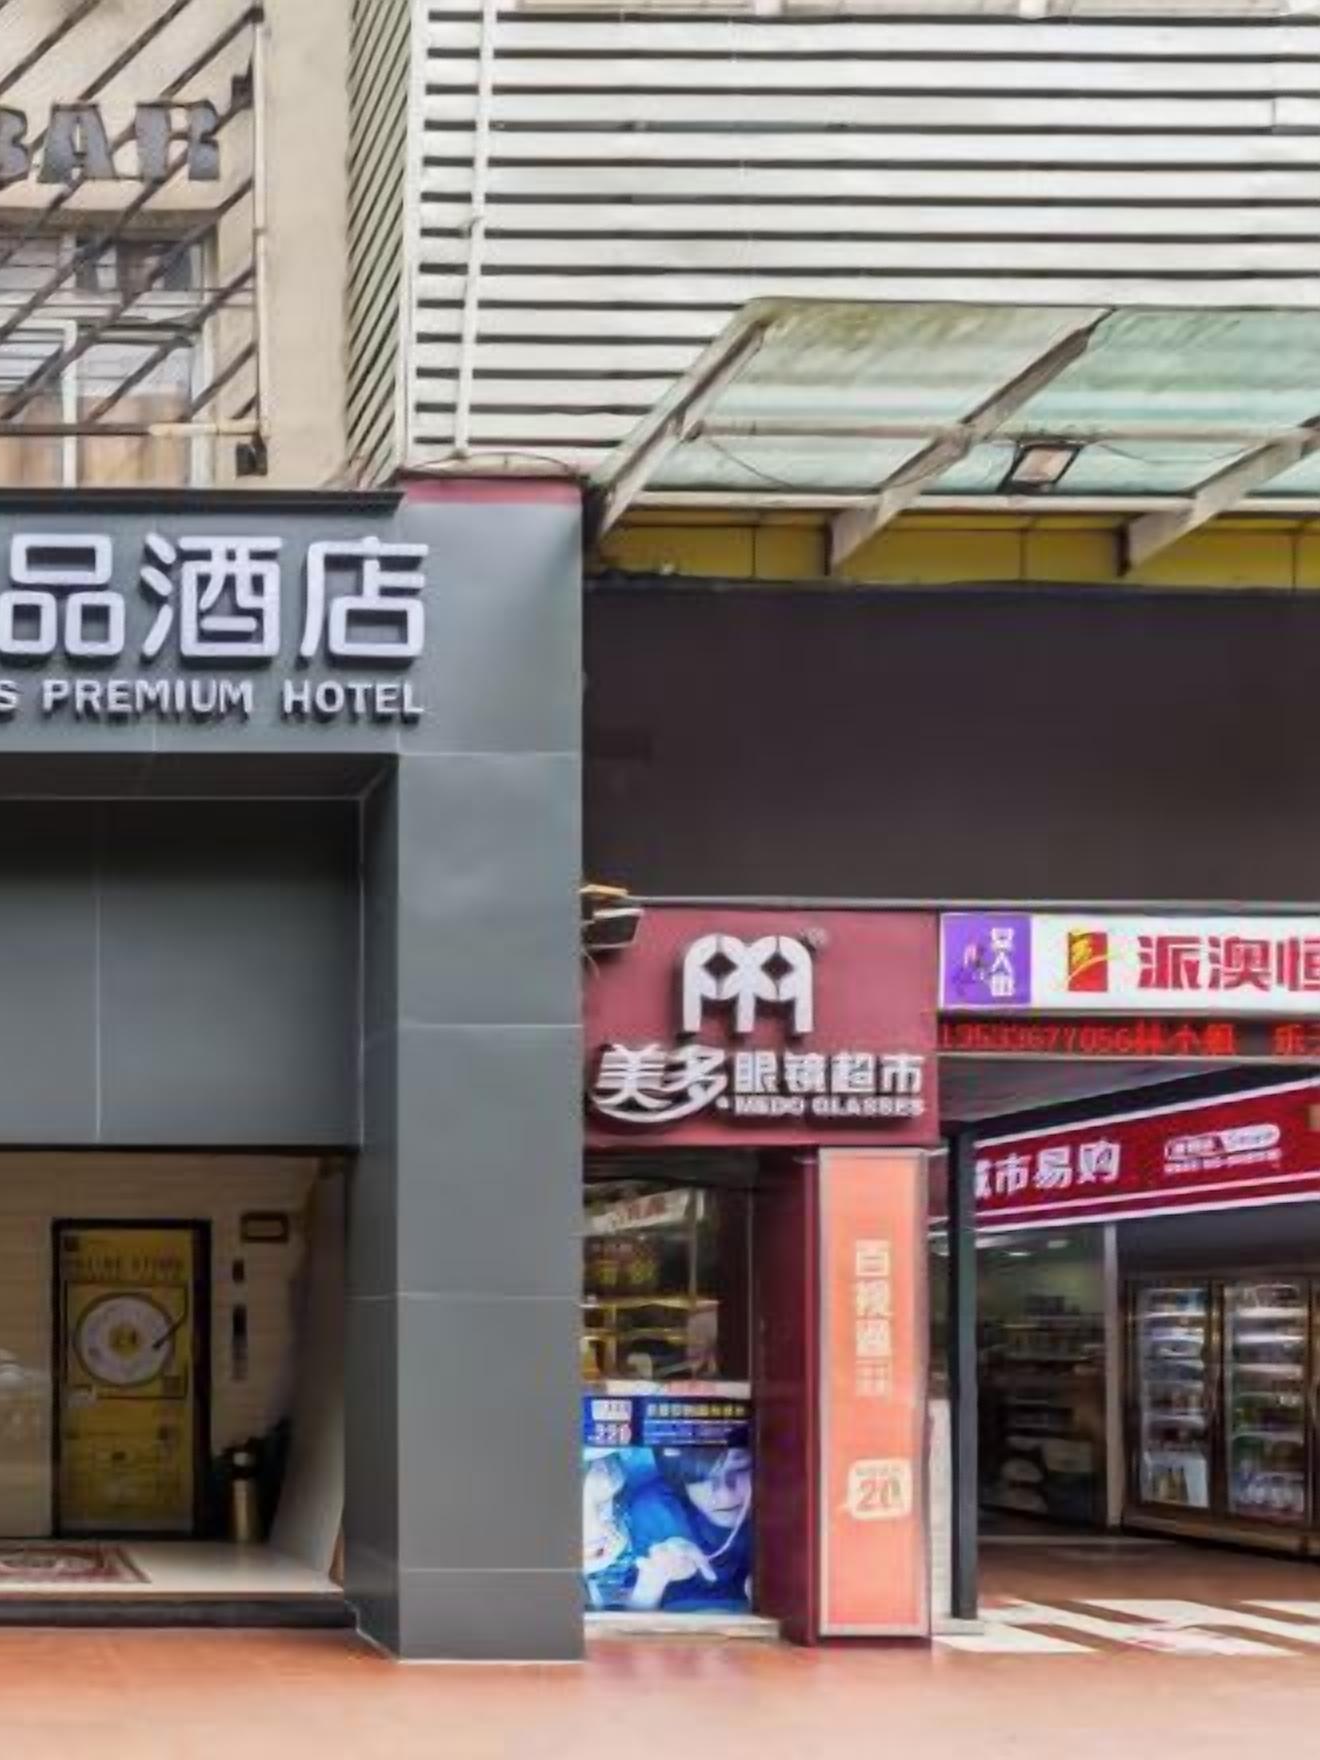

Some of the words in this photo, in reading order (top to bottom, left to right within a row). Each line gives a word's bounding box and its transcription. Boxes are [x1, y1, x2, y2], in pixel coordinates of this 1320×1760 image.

[43, 679, 254, 713] PREMIUM
[283, 680, 426, 715] HOTEL
[591, 1043, 728, 1123] 美多
